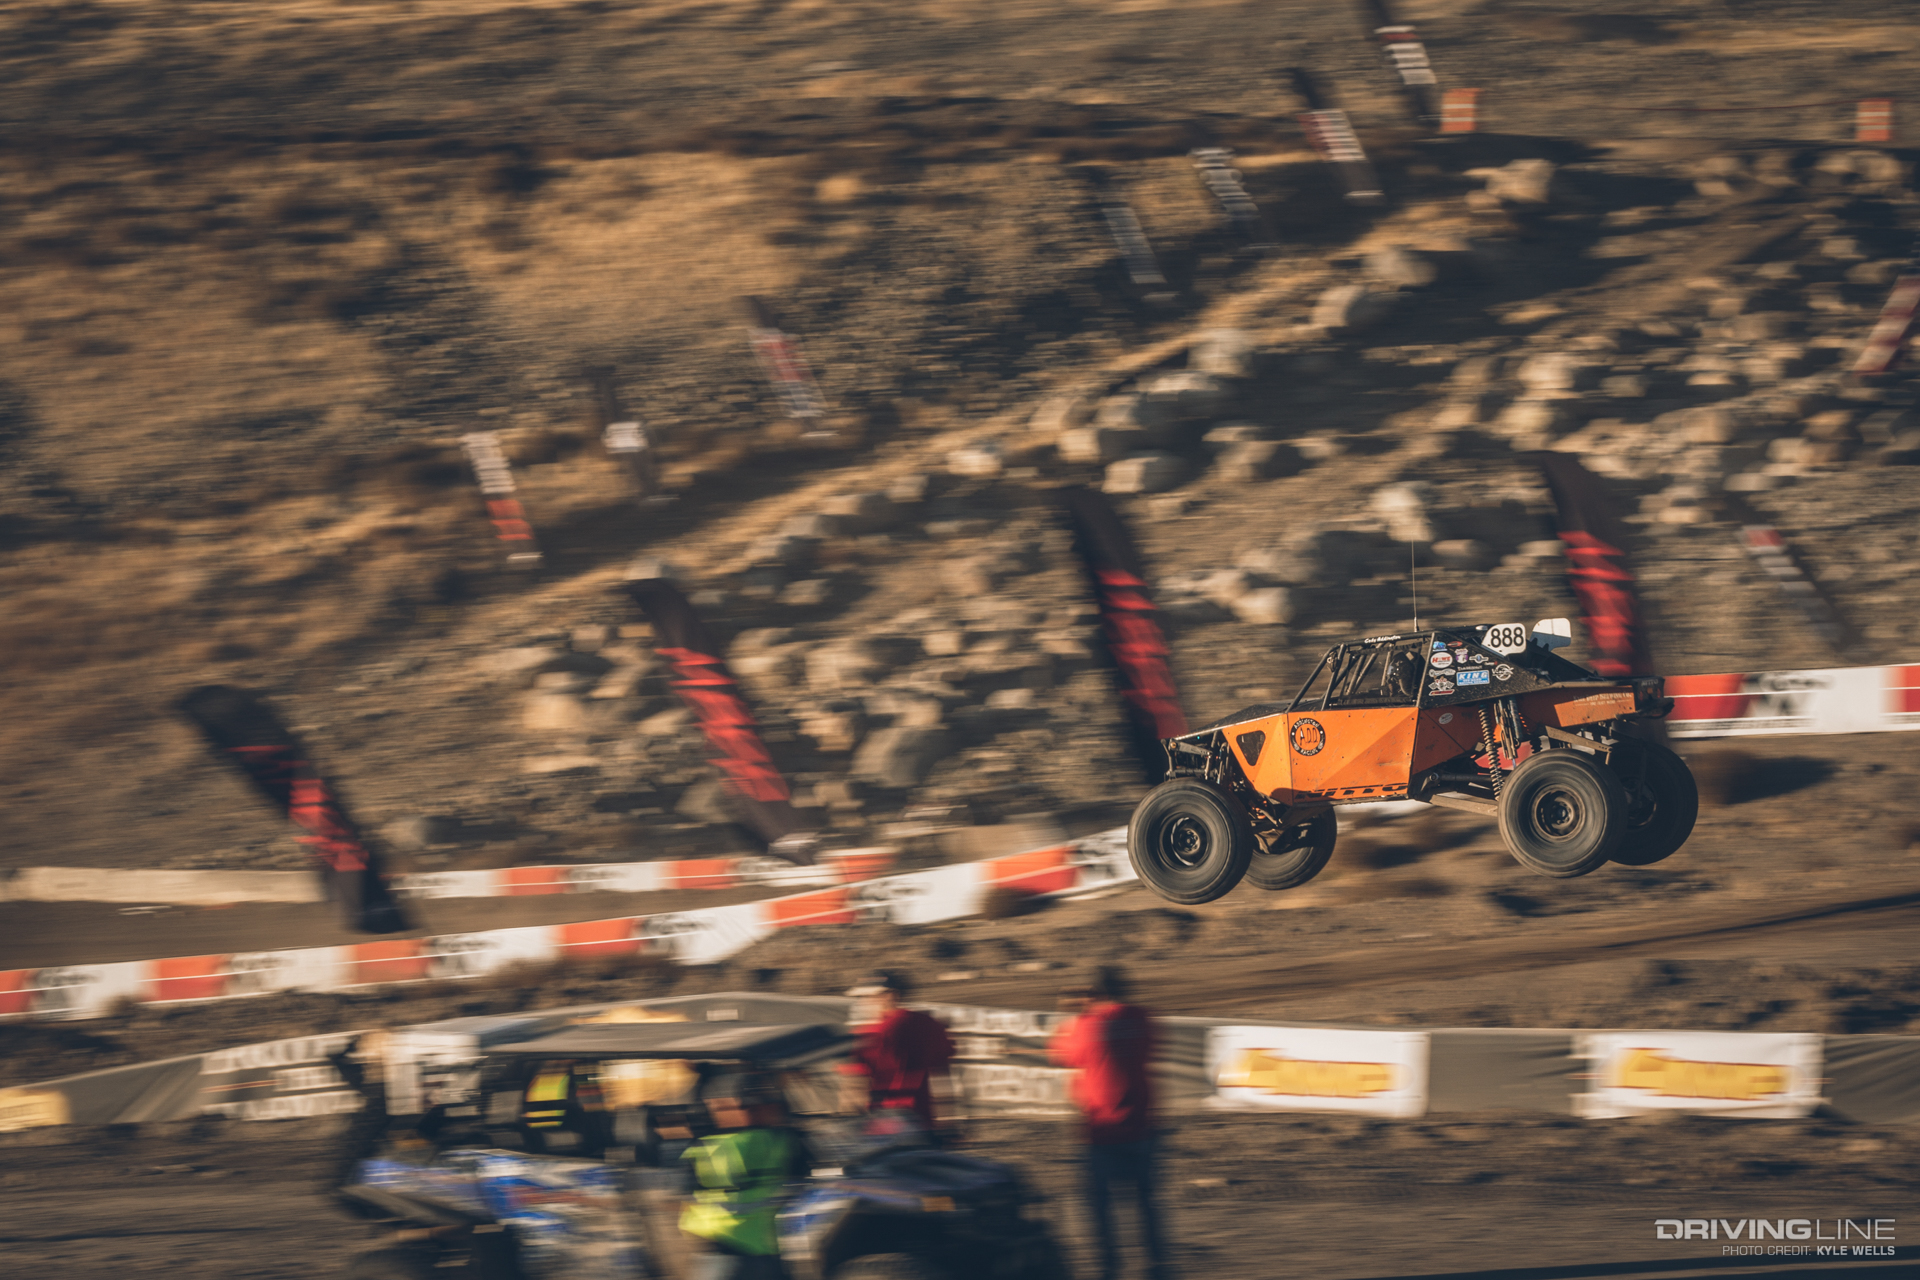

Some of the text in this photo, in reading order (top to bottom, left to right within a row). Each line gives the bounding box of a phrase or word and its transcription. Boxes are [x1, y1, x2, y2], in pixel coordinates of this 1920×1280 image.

[1491, 627, 1524, 648] 888
[1459, 672, 1487, 680] KING
[1295, 782, 1408, 799] NITTO
